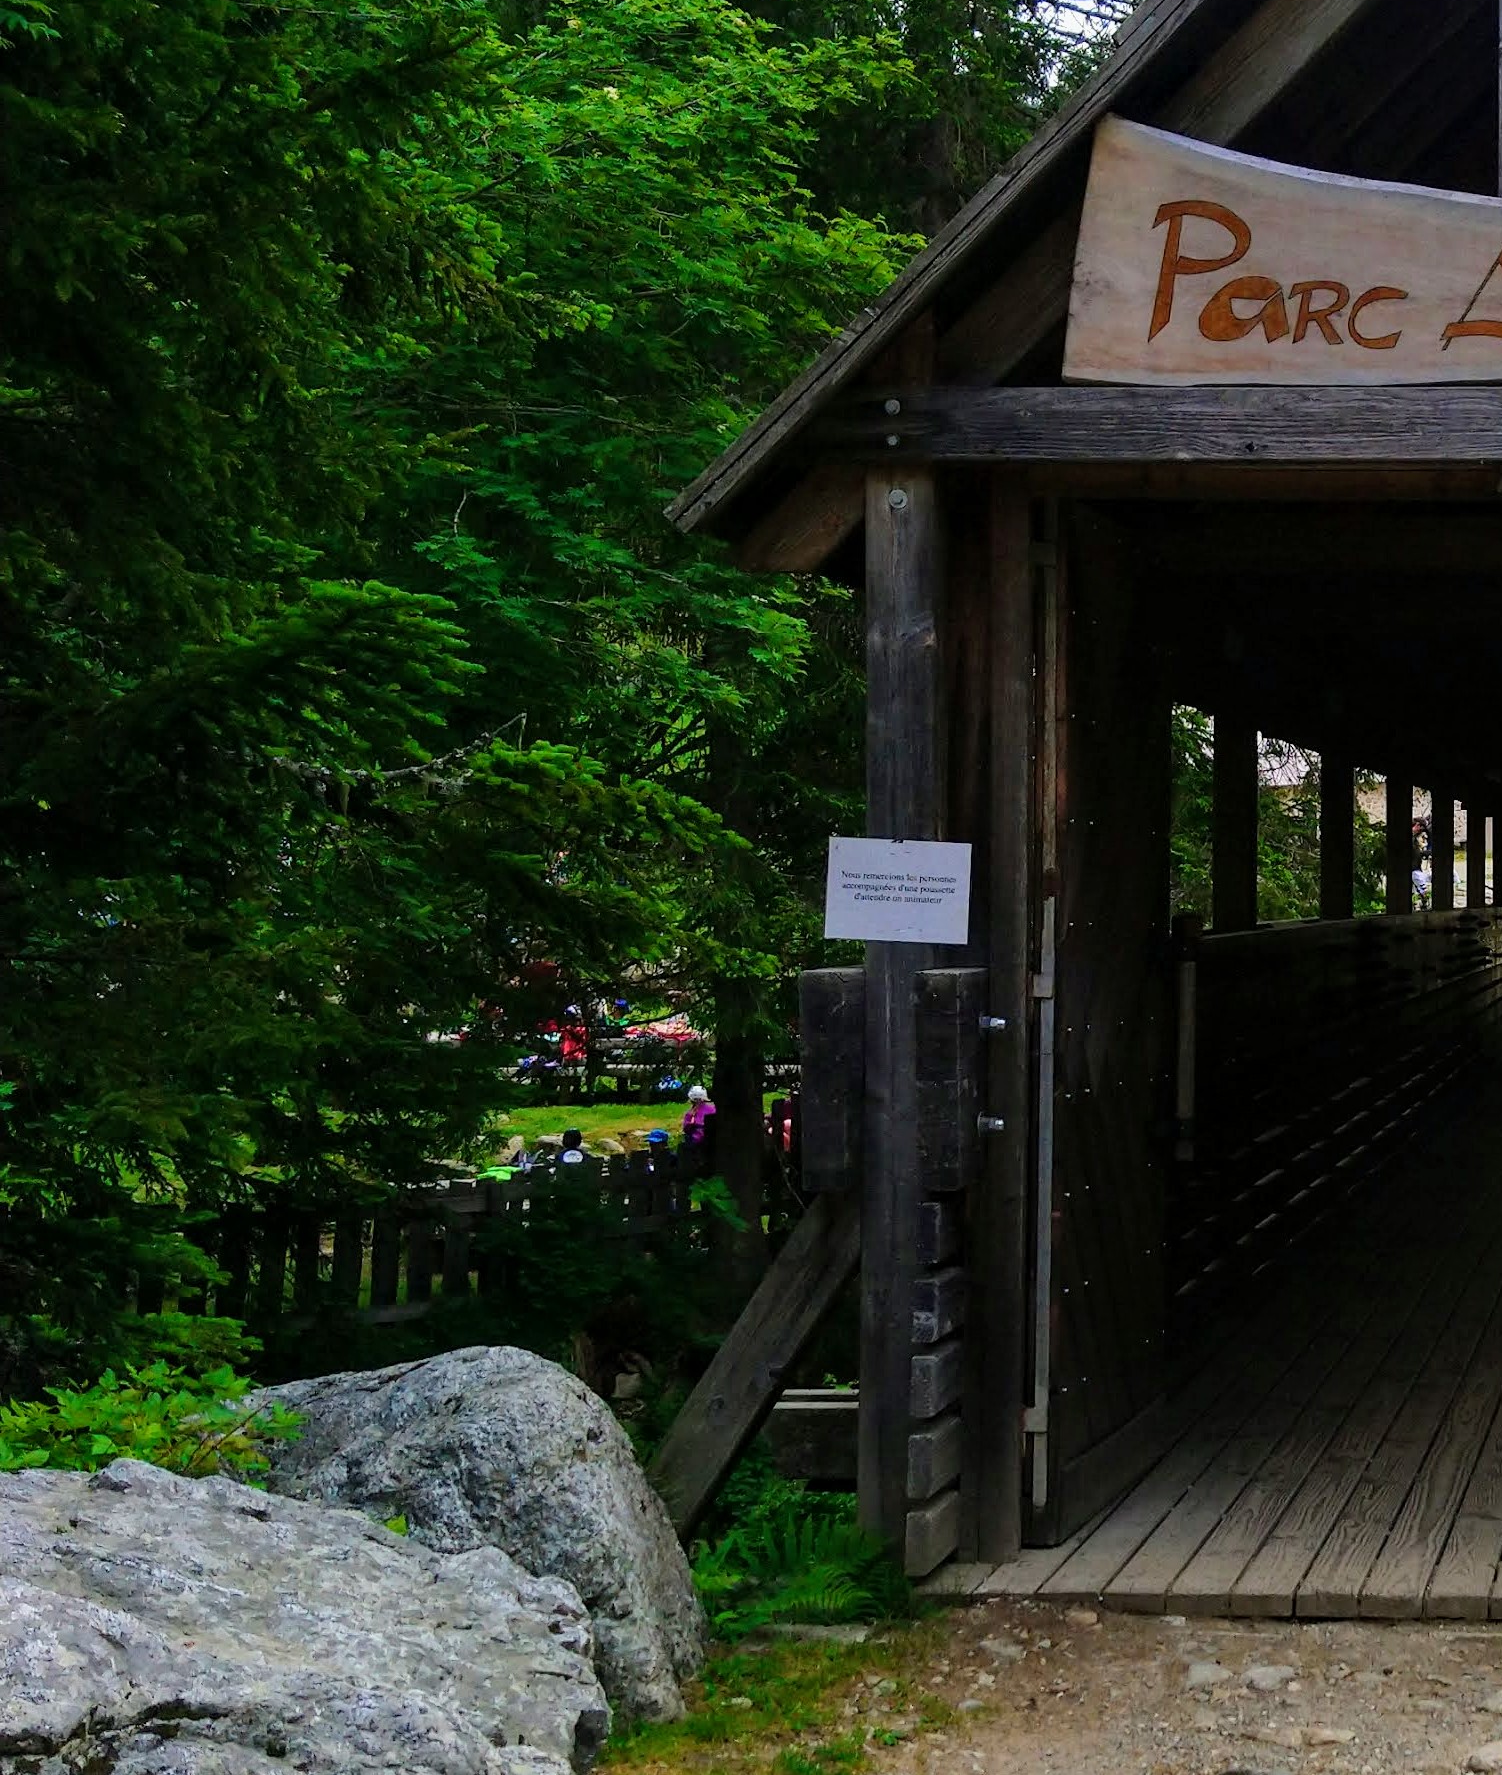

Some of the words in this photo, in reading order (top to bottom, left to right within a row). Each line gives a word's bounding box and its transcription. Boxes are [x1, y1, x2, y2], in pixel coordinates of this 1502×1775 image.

[841, 870, 861, 879] Nous
[863, 873, 905, 882] remercions
[906, 874, 917, 882] les
[919, 875, 957, 884] personnes
[898, 884, 918, 893] d'une
